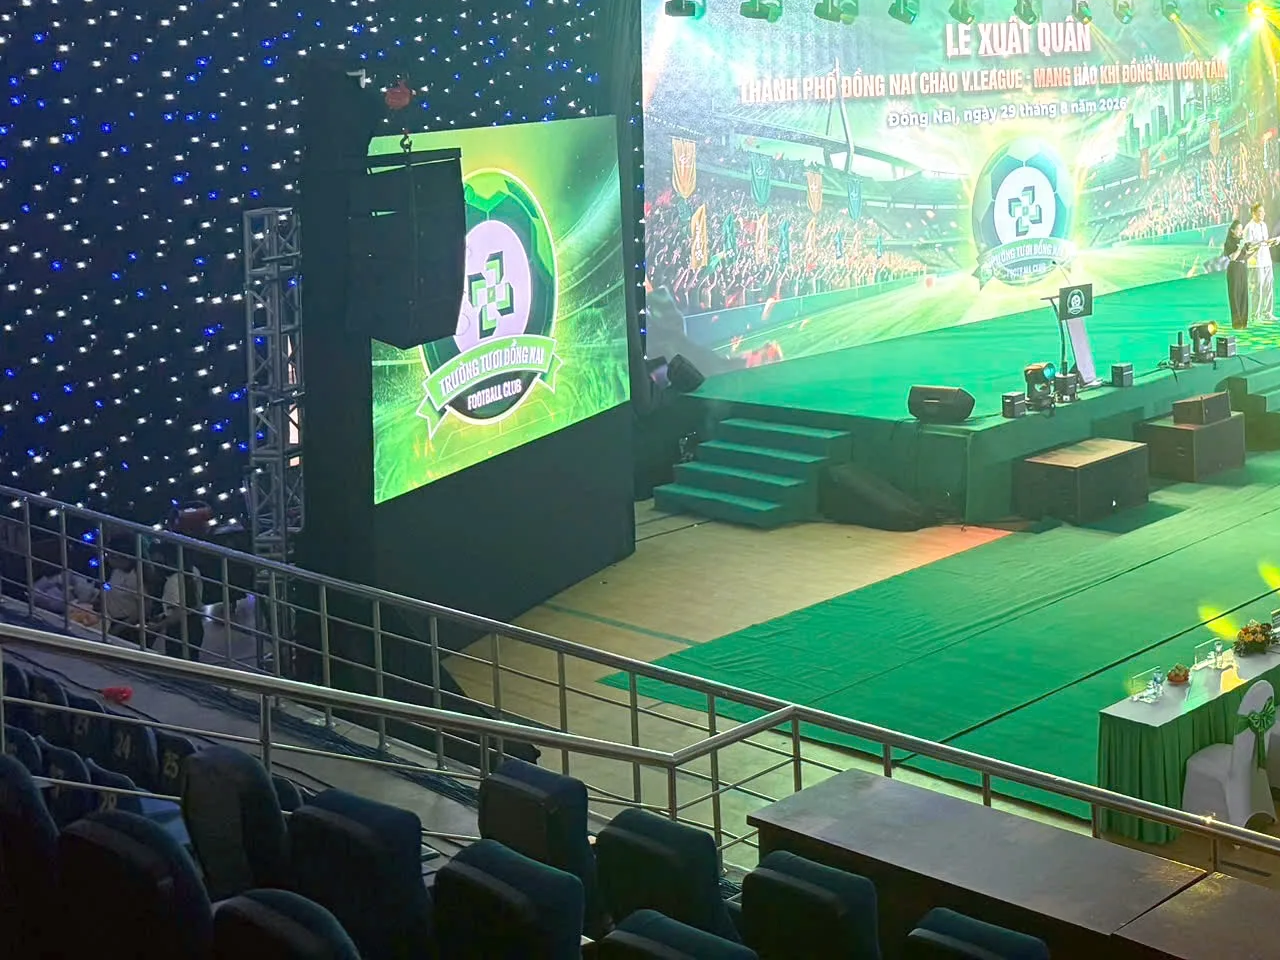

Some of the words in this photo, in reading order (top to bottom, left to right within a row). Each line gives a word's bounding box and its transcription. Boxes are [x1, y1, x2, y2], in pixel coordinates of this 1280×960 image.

[1038, 15, 1092, 57] QUÂN
[889, 72, 917, 96] NAI
[961, 68, 1024, 92] V.LEAGUE
[1033, 67, 1072, 88] MANG
[1154, 62, 1174, 81] NAI
[1000, 104, 1016, 118] 29
[467, 383, 504, 411] FOOTBALL
[503, 378, 522, 397] CLUB
